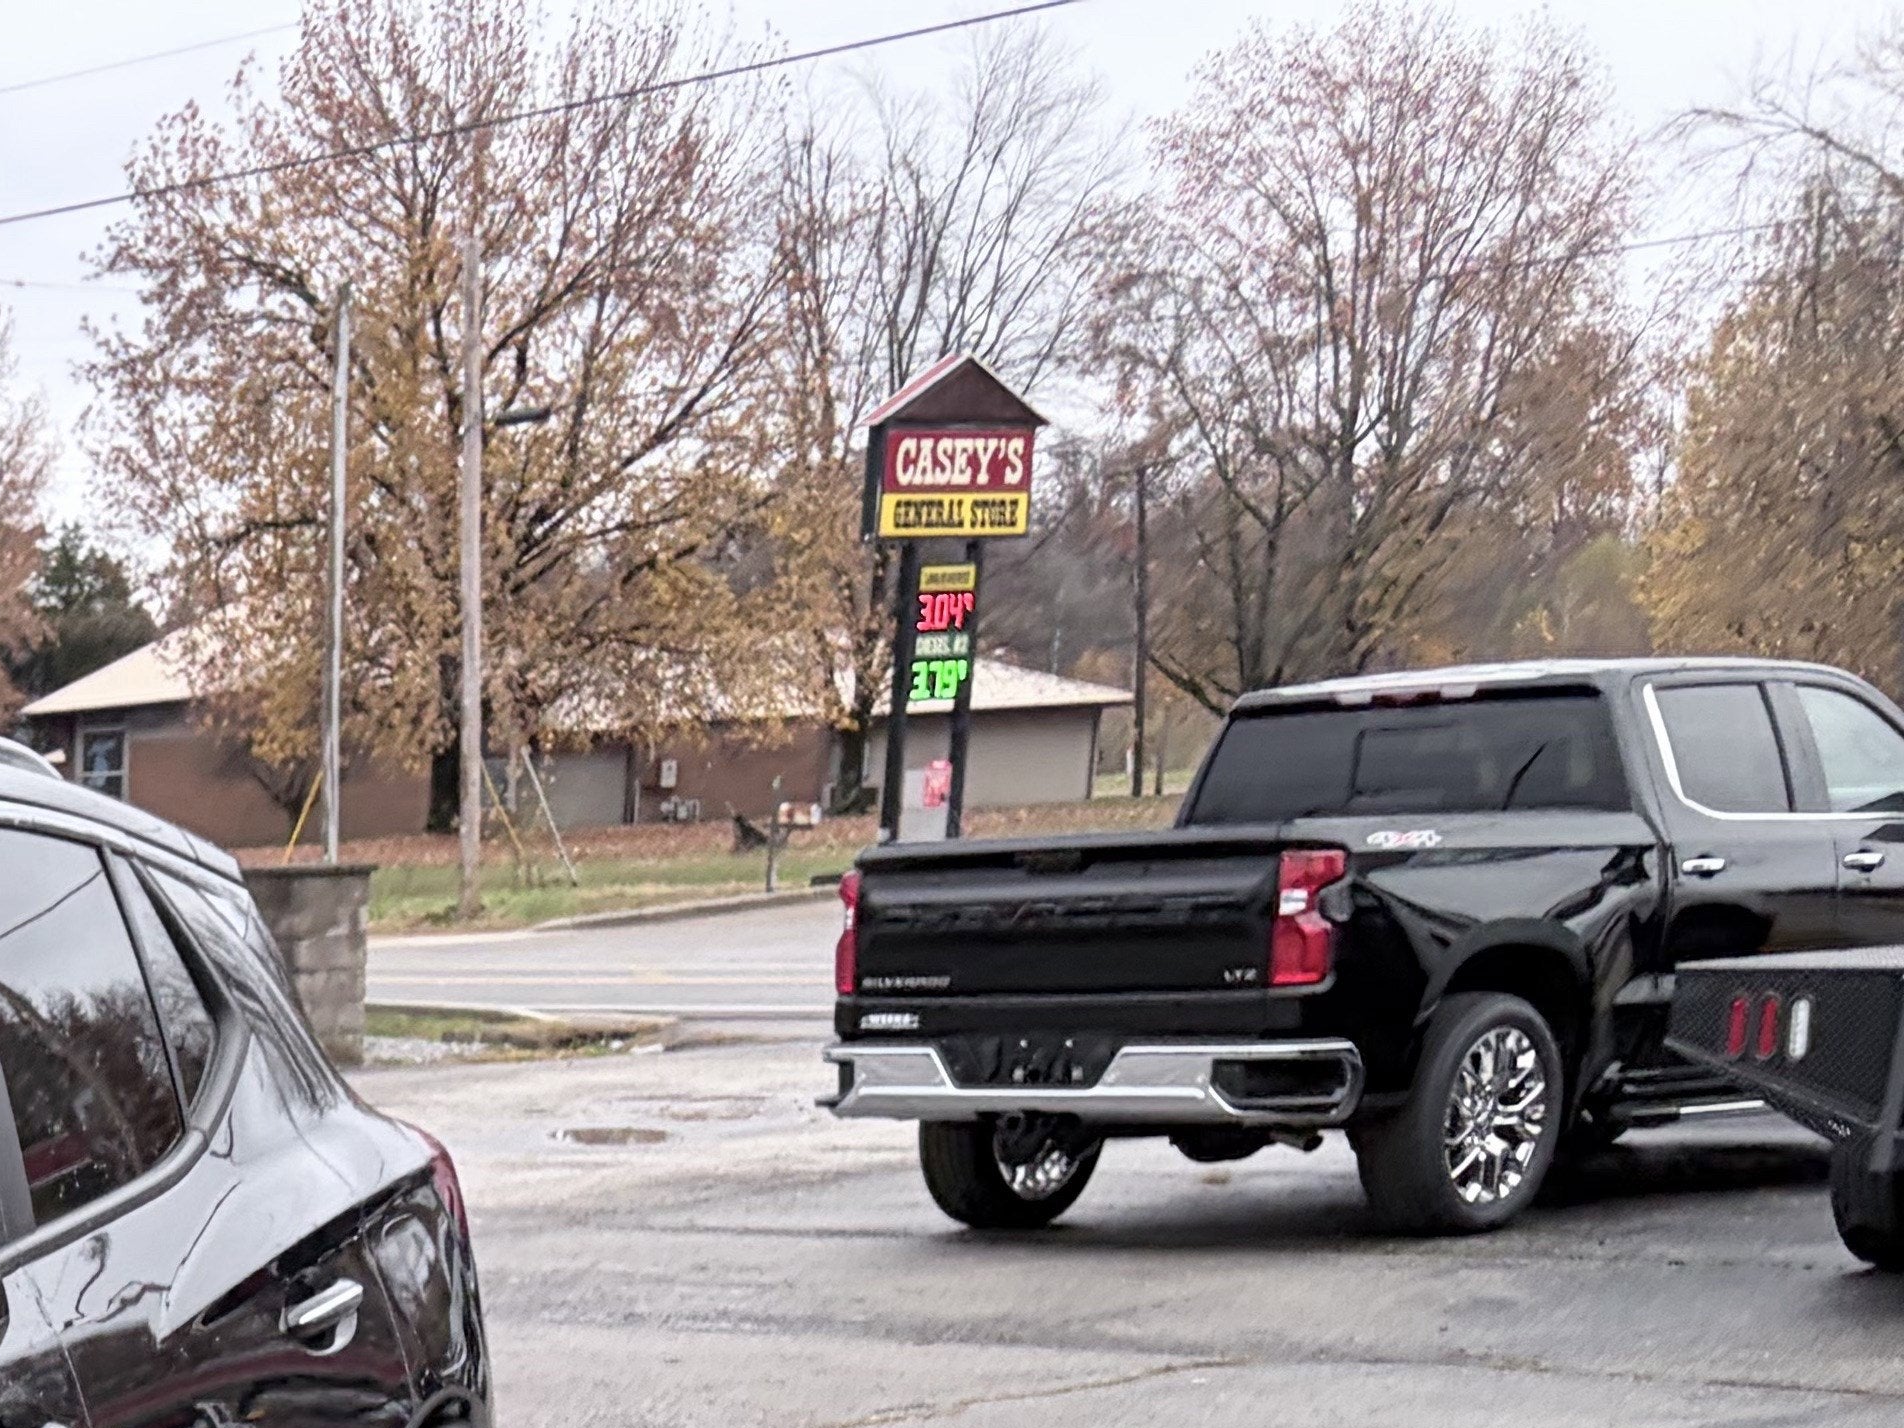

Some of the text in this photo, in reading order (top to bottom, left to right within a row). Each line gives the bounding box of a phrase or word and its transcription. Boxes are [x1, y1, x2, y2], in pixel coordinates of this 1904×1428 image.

[896, 437, 1025, 486] CASEY'S
[894, 499, 1020, 528] GENERAL STORE
